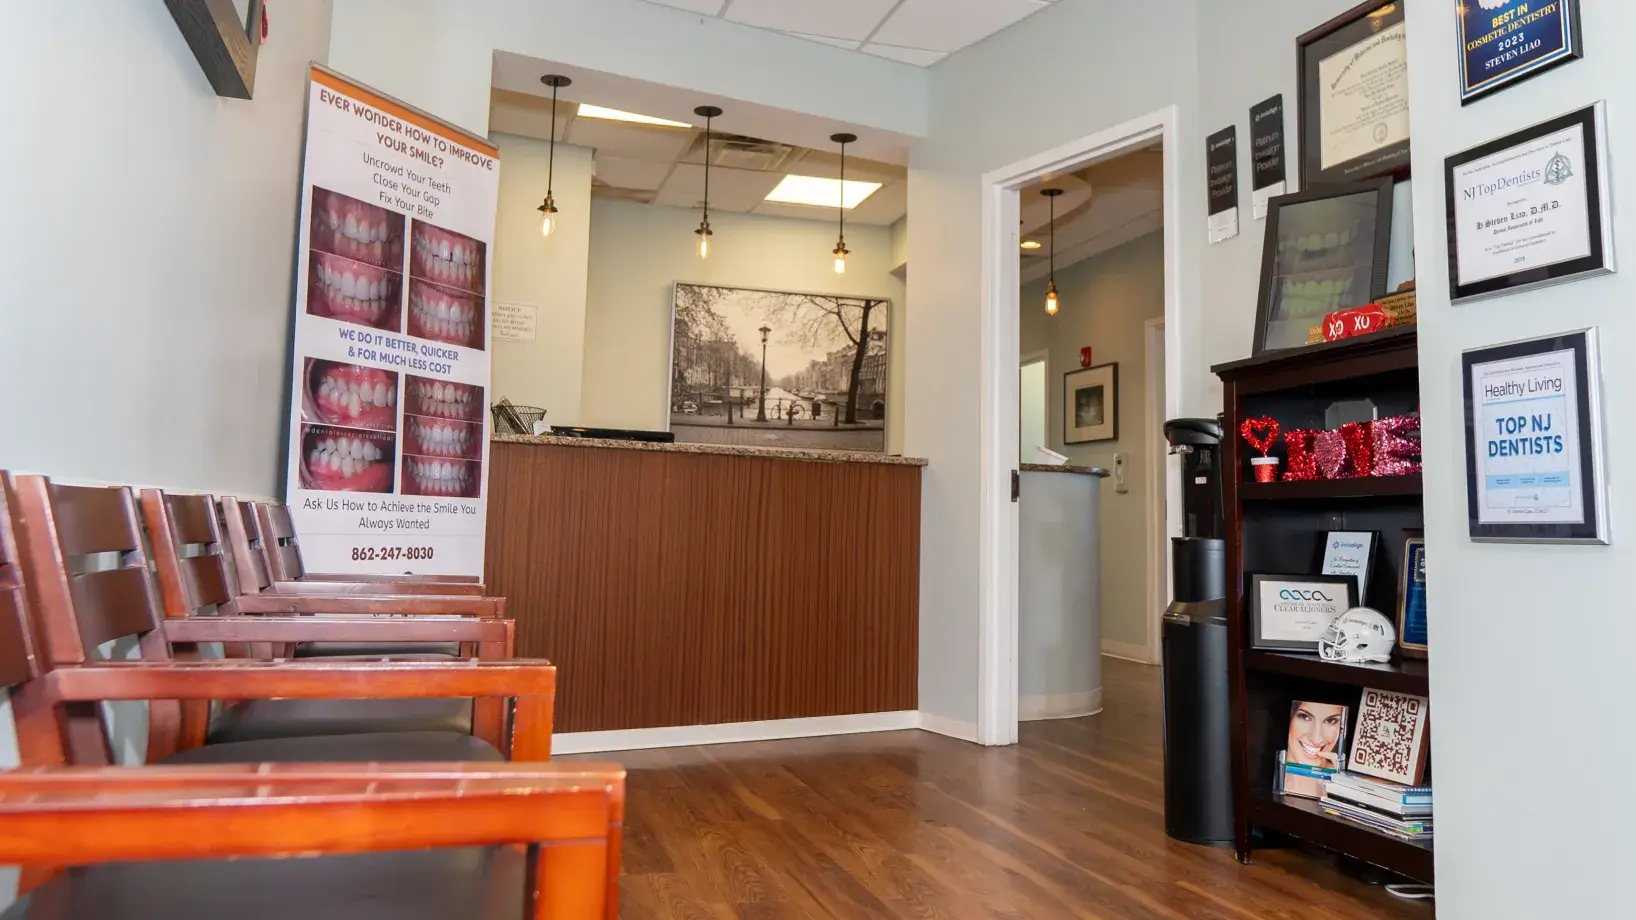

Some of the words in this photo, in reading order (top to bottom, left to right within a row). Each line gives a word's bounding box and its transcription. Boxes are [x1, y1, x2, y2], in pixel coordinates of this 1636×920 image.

[1467, 26, 1508, 51] COSMETIC
[1508, 2, 1558, 32] DENTISTRY
[1492, 10, 1515, 28] BEST
[1517, 3, 1528, 15] IN
[1485, 49, 1518, 70] STEVEN
[1520, 39, 1541, 55] LIAO
[1498, 32, 1525, 51] 2023
[320, 89, 350, 113] EVER
[353, 103, 402, 134] WONDER
[405, 125, 431, 145] HOW
[433, 137, 447, 152] TO
[449, 144, 493, 171] IMPROVE
[376, 132, 407, 155] YOUR
[410, 146, 444, 169] SMILE?
[363, 152, 404, 176] Uncrowd
[407, 166, 426, 185] Your
[428, 177, 451, 194] Teeth
[373, 173, 399, 191] Close
[401, 182, 421, 199] Your
[423, 191, 440, 207] Gap
[379, 191, 393, 205] Fix
[395, 197, 415, 212] Your
[417, 205, 434, 220] Bite
[339, 327, 355, 342] WE
[357, 332, 372, 344] DO
[374, 335, 383, 346] IT
[385, 337, 419, 355] BETTER,
[420, 344, 459, 361] QUICKER
[348, 345, 356, 357] &
[357, 348, 377, 361] FOR
[379, 352, 407, 367] MUCH
[408, 358, 427, 371] LESS
[428, 362, 452, 374] COST
[1485, 380, 1525, 397] Healthy
[1528, 376, 1562, 393] Living
[1495, 415, 1527, 435] TOP
[1531, 413, 1551, 433] NJ
[1488, 435, 1564, 458] DENTISTS
[303, 498, 323, 510] Ask
[326, 498, 339, 511] Us
[342, 499, 365, 511] How
[368, 501, 378, 512] to
[380, 501, 415, 513] Achieve
[417, 502, 432, 513] the
[433, 503, 458, 514] Smile
[461, 504, 476, 515] You
[358, 517, 394, 531] Always
[396, 518, 430, 529] Wanted
[351, 547, 434, 561] 862-247-8030
[1274, 603, 1298, 612] CLEAR
[1299, 604, 1336, 613] ALIGNERS
